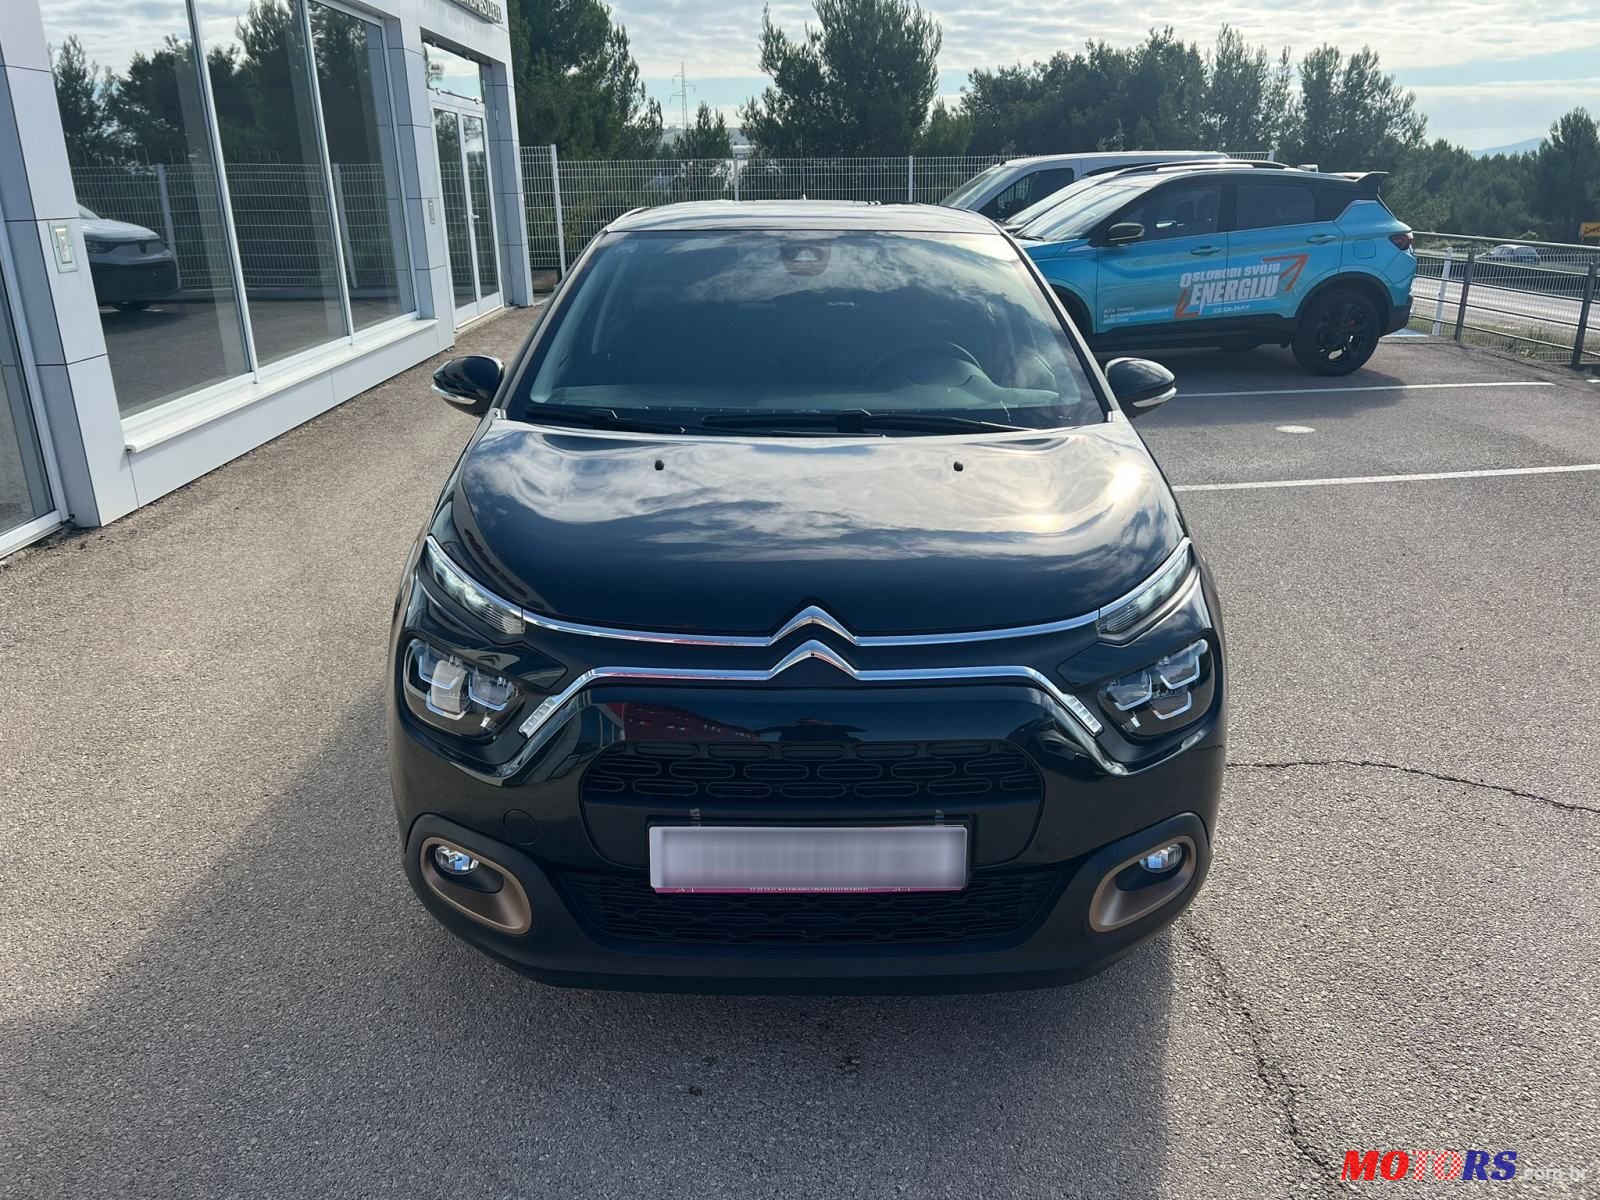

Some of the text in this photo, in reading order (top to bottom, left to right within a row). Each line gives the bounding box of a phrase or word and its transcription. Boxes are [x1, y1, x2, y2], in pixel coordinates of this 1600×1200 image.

[1180, 262, 1280, 288] OSLOBODI SVOJU
[1189, 275, 1280, 308] ENERGIJU
